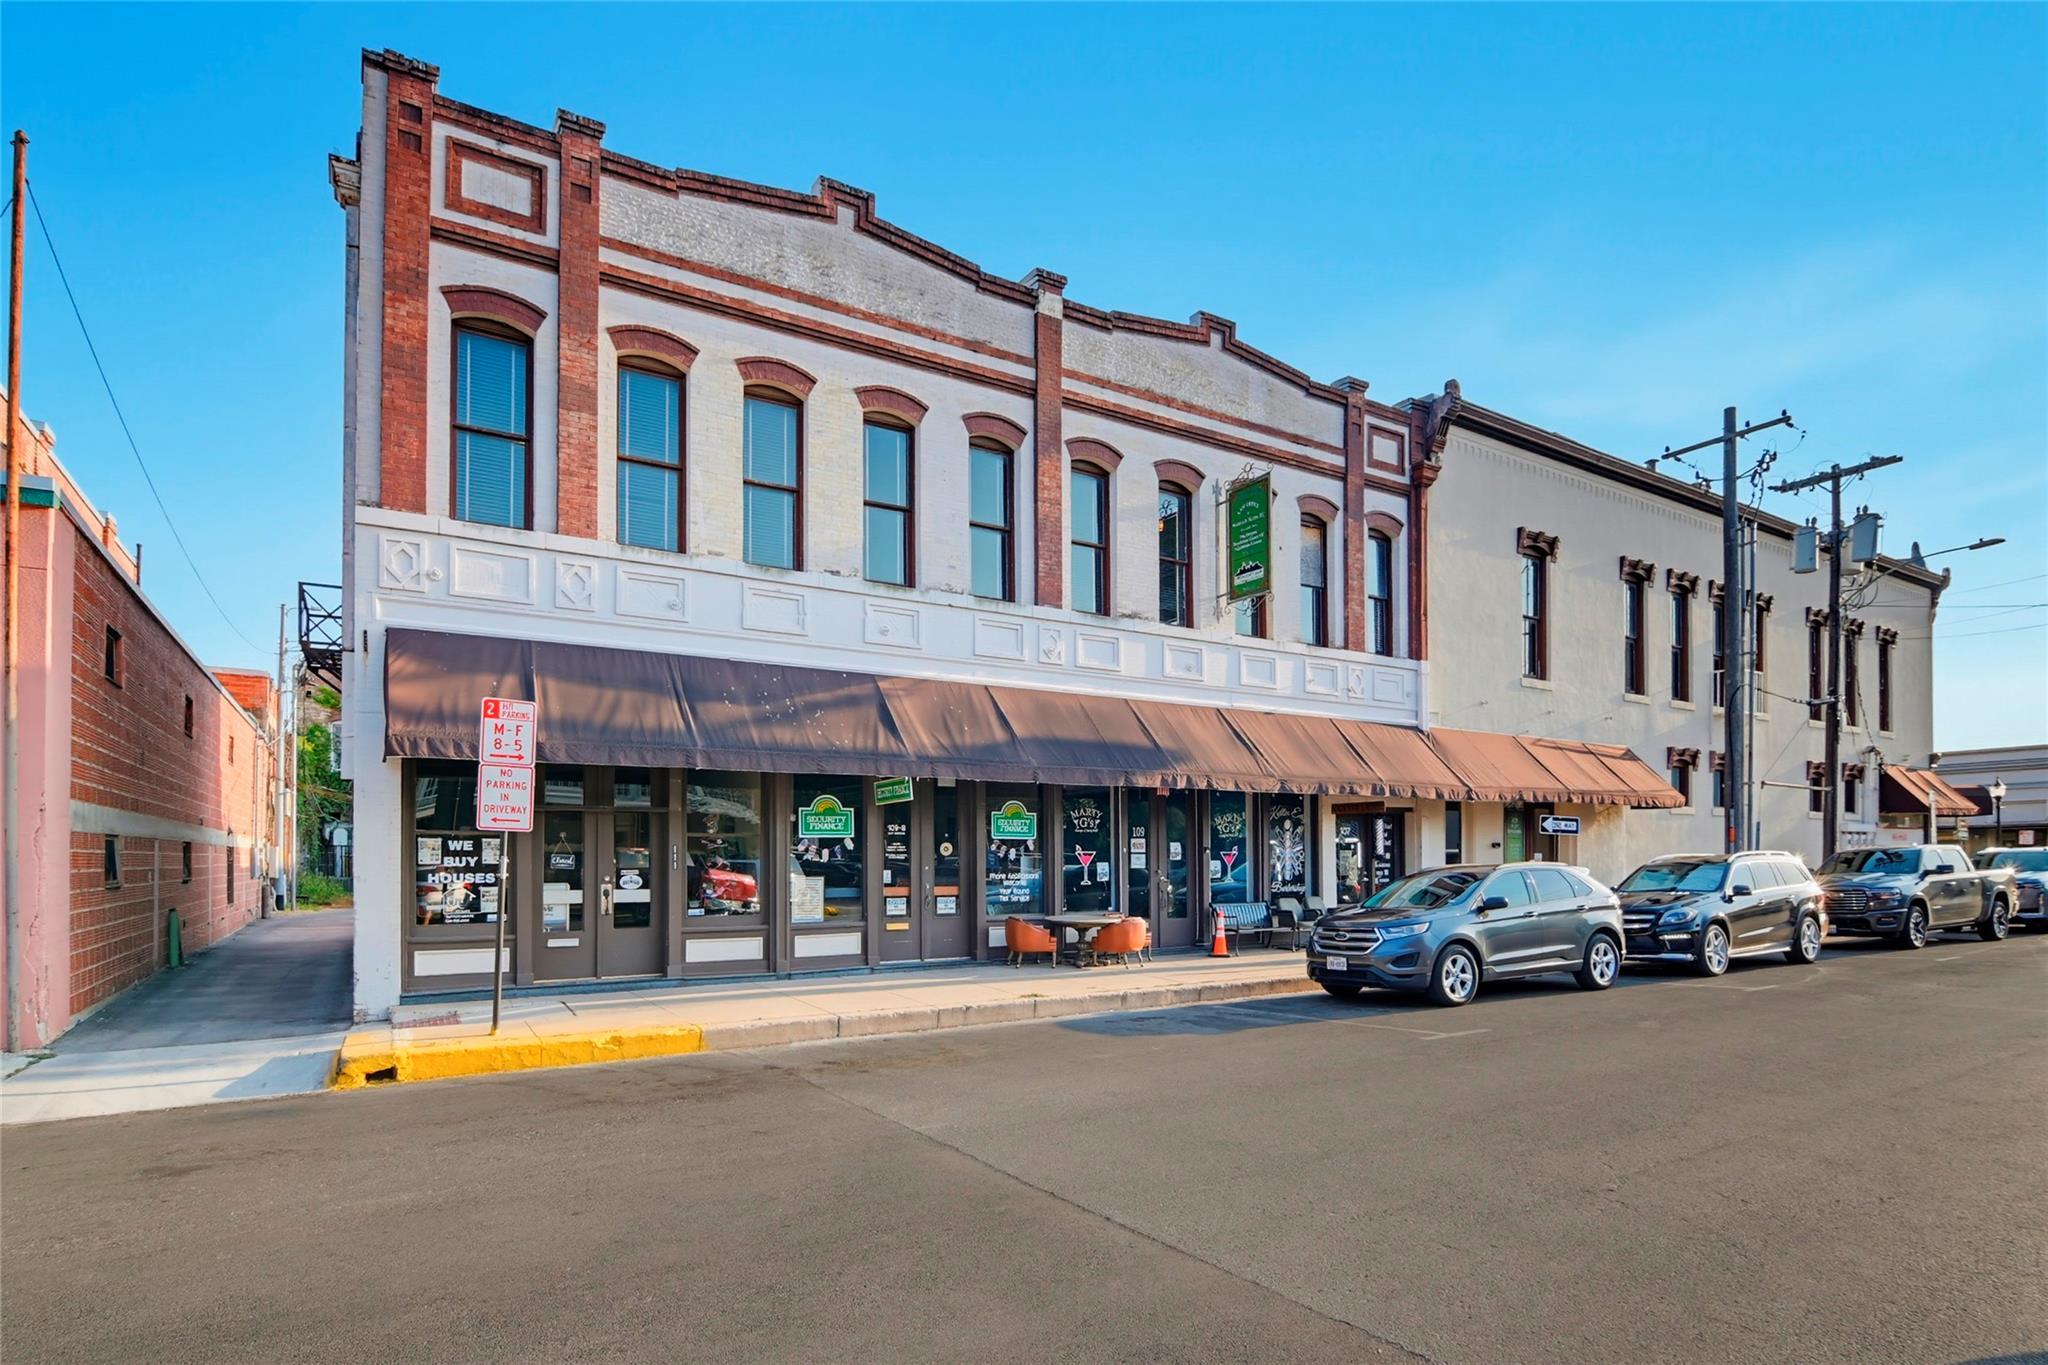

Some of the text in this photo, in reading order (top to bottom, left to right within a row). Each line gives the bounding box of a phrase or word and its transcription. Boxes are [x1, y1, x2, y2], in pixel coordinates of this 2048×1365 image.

[487, 702, 495, 715] 2
[502, 711, 531, 720] PARKING
[500, 769, 512, 777] NO
[486, 780, 528, 791] PARKING
[500, 793, 509, 801] IN
[483, 804, 528, 814] DRIVEWAY
[1070, 807, 1103, 818] MARTY
[806, 815, 846, 823] SECURITY
[1132, 826, 1145, 837] 109
[447, 840, 473, 851] WE
[443, 856, 478, 867] BUY
[427, 873, 496, 884] HOUSES
[990, 872, 1006, 880] Phone
